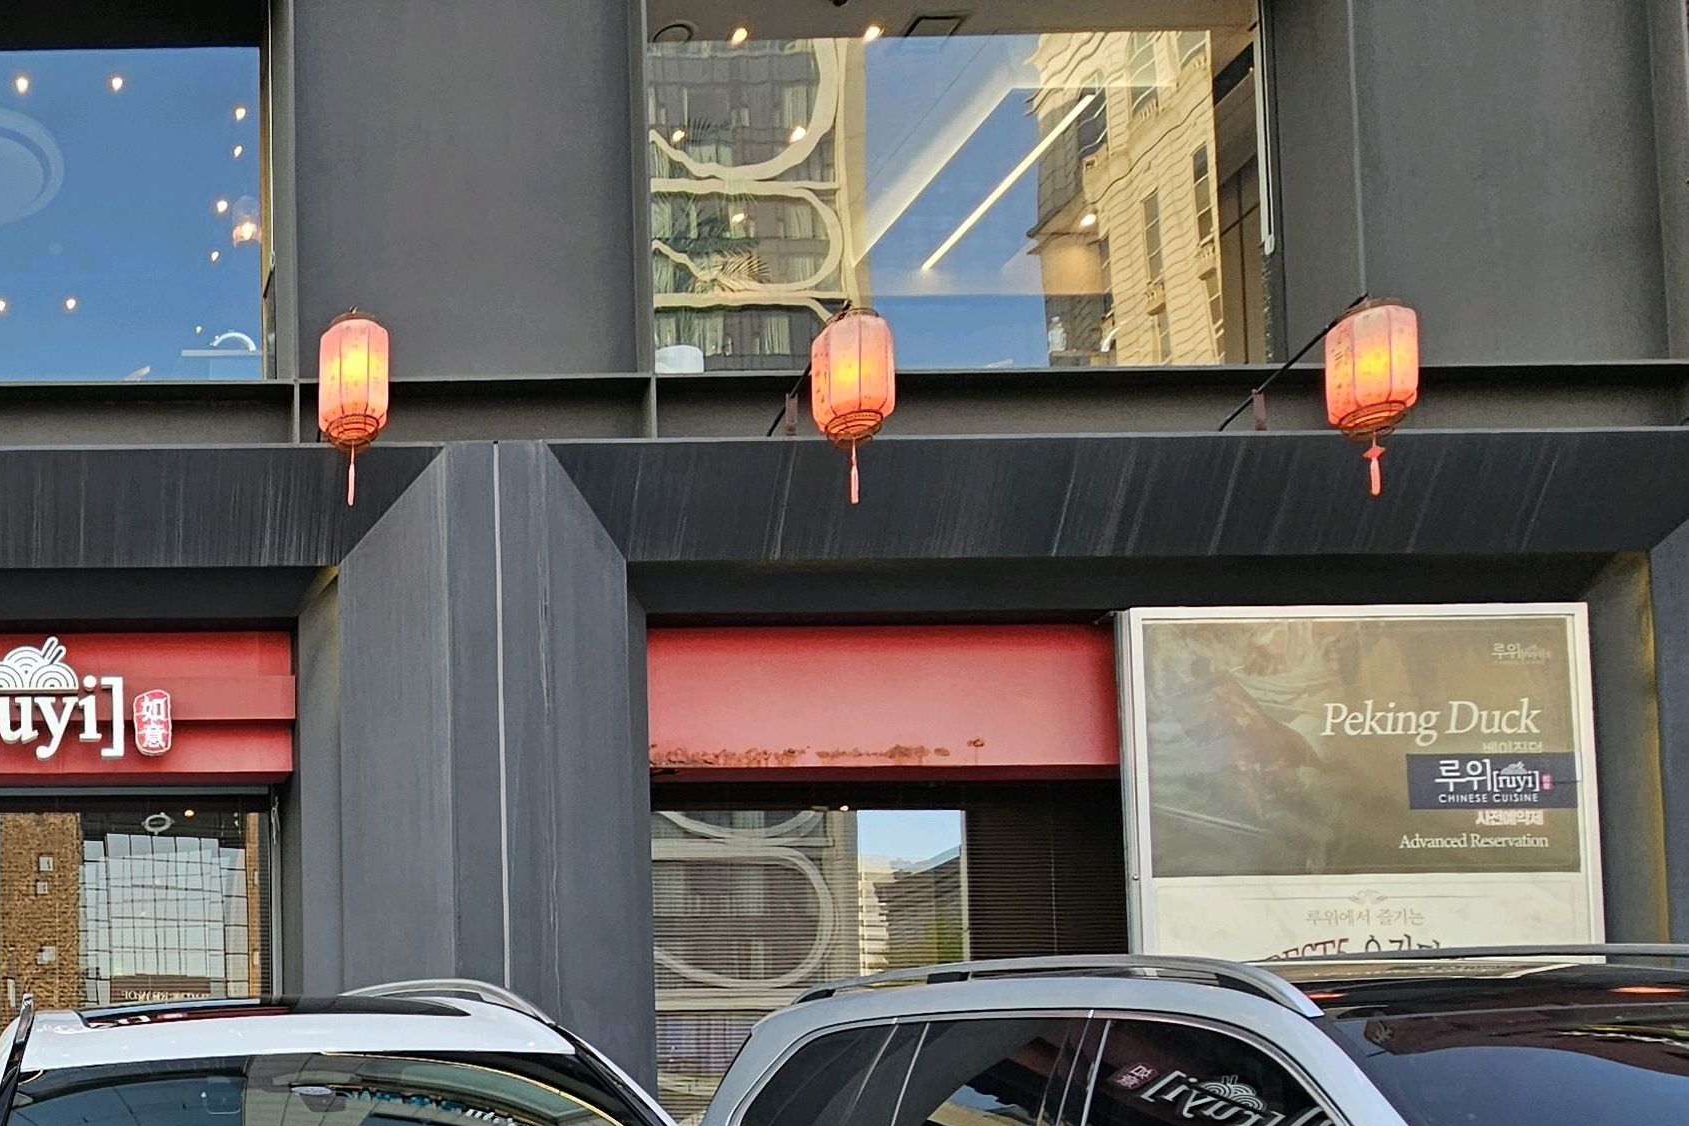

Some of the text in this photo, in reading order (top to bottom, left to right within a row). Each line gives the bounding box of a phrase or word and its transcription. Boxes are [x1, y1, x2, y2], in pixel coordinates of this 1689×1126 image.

[140, 697, 168, 749] 如意
[1321, 697, 1542, 746] Peking Duck
[1435, 758, 1491, 792] 루위
[1438, 793, 1539, 803] CHINESE CUISINE
[1399, 833, 1549, 849] Advanced Reservation
[1305, 907, 1425, 926] 루위에서 즐기는
